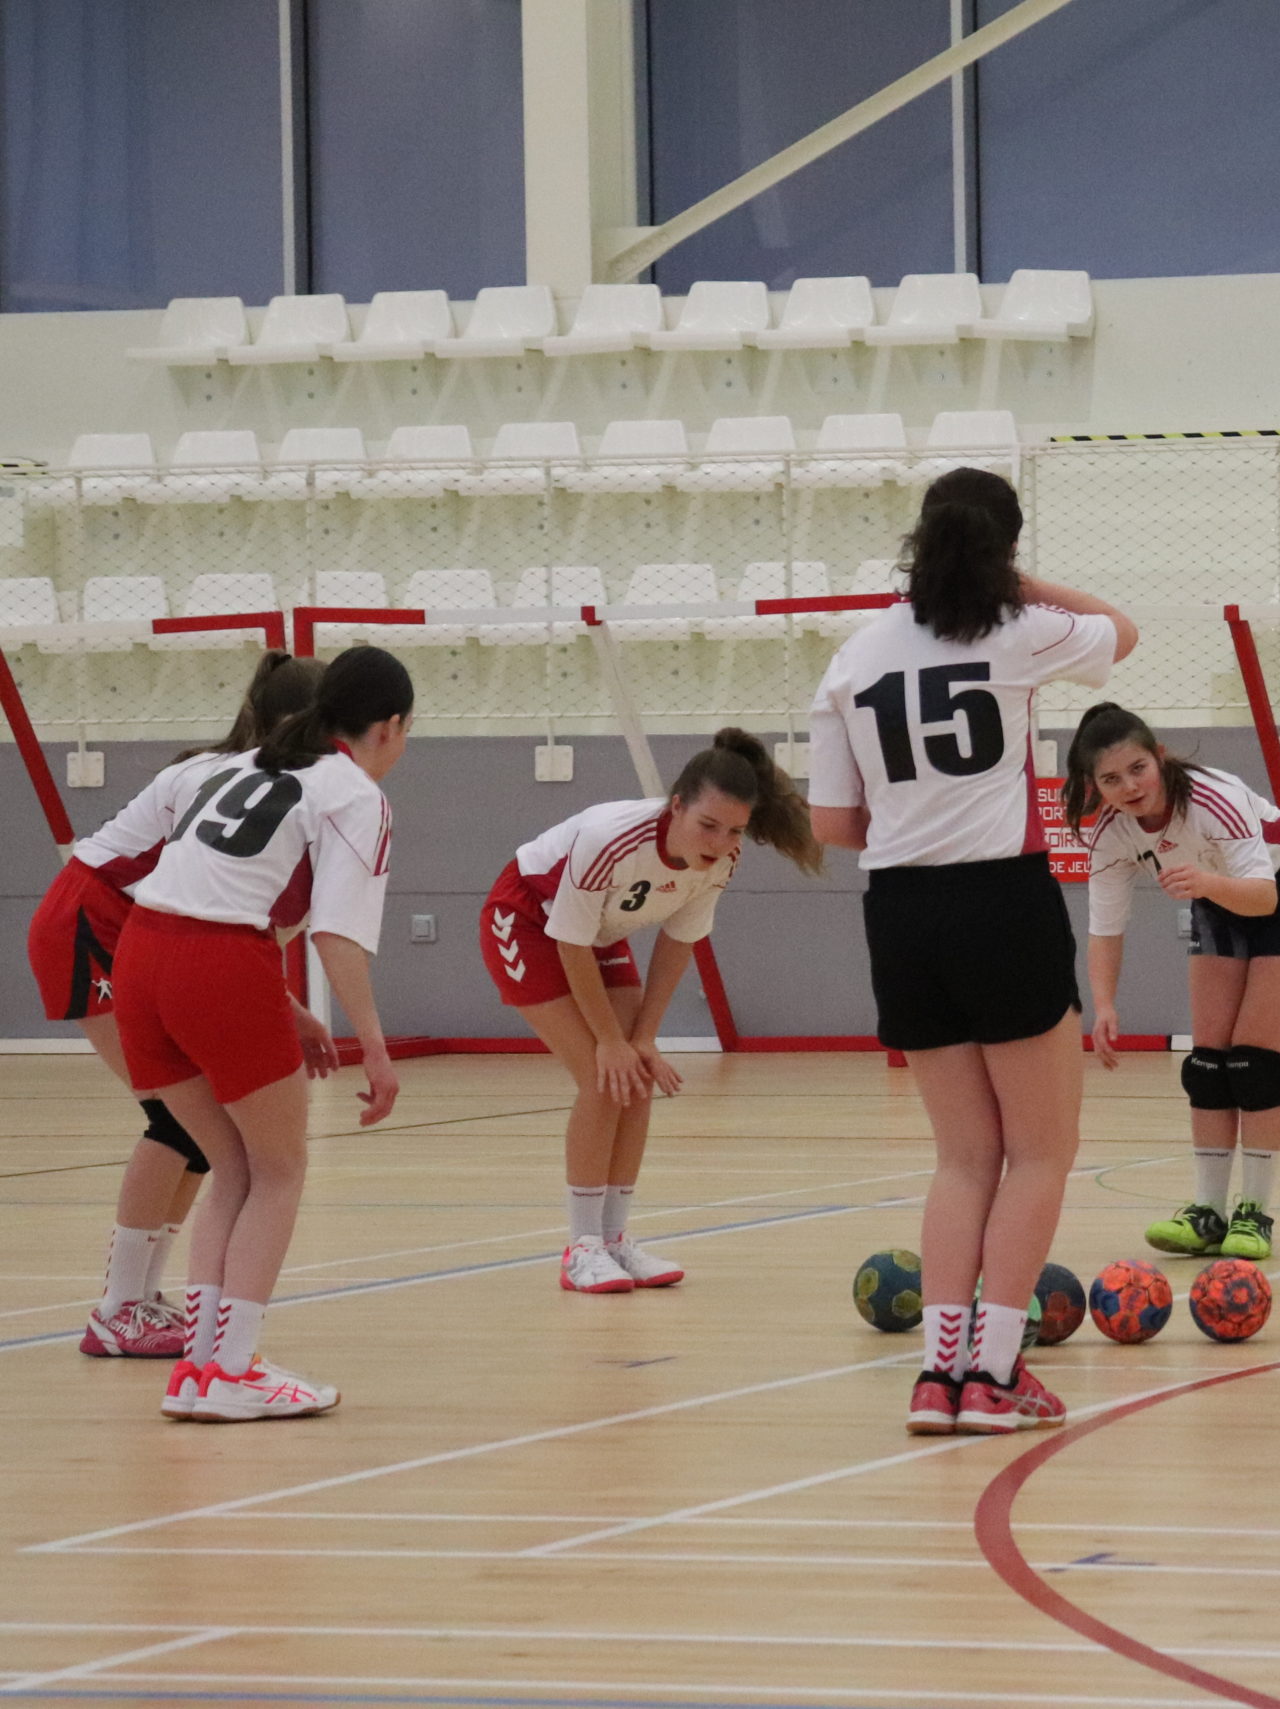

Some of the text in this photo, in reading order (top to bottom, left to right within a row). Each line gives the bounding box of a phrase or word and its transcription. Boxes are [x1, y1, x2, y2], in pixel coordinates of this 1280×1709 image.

[853, 660, 1005, 784] 15
[166, 766, 303, 859] 19
[619, 880, 652, 912] 3
[1049, 861, 1065, 873] DE
